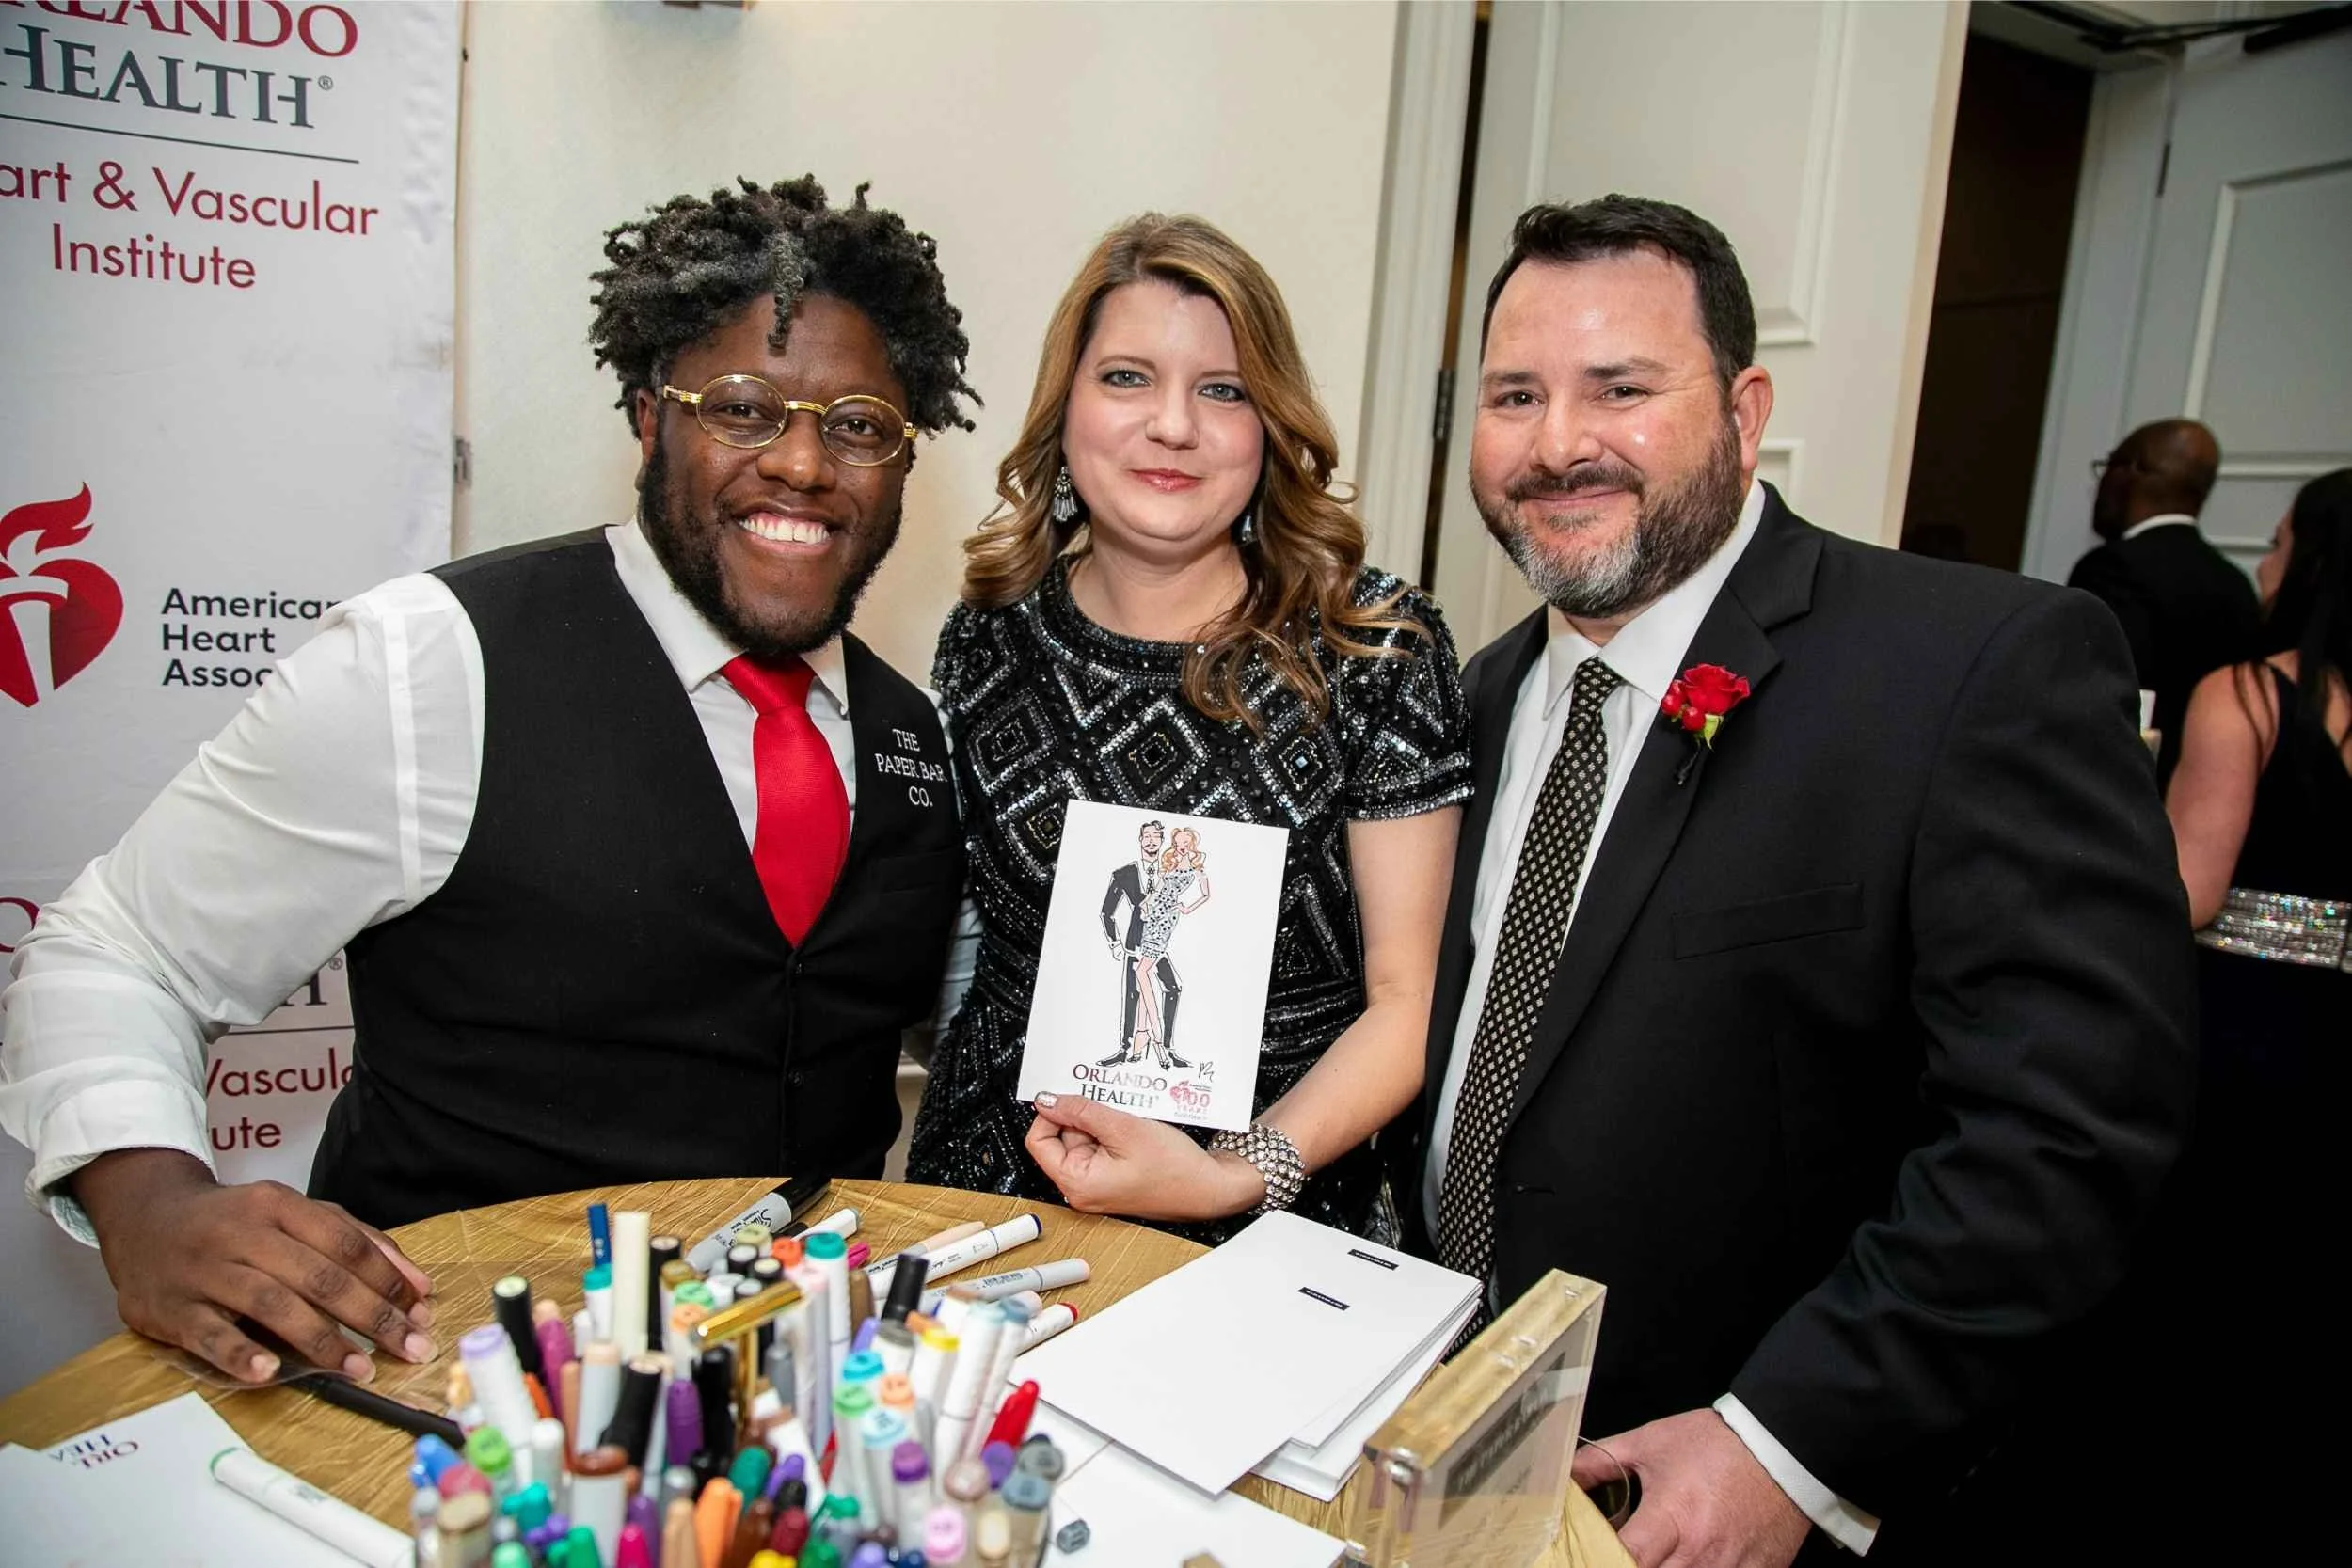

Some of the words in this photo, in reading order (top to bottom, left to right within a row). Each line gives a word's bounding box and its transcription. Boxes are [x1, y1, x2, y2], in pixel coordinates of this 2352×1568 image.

[93, 161, 138, 212] &
[152, 166, 379, 235] Vascular
[53, 223, 256, 289] Institute
[162, 588, 343, 620] America
[162, 624, 276, 654] Heart
[892, 728, 920, 752] THE
[874, 752, 919, 779] PAPER
[918, 761, 948, 783] BAR
[908, 785, 933, 807] CO.
[1073, 1064, 1168, 1092] ORLANDO
[211, 1117, 282, 1151] ute
